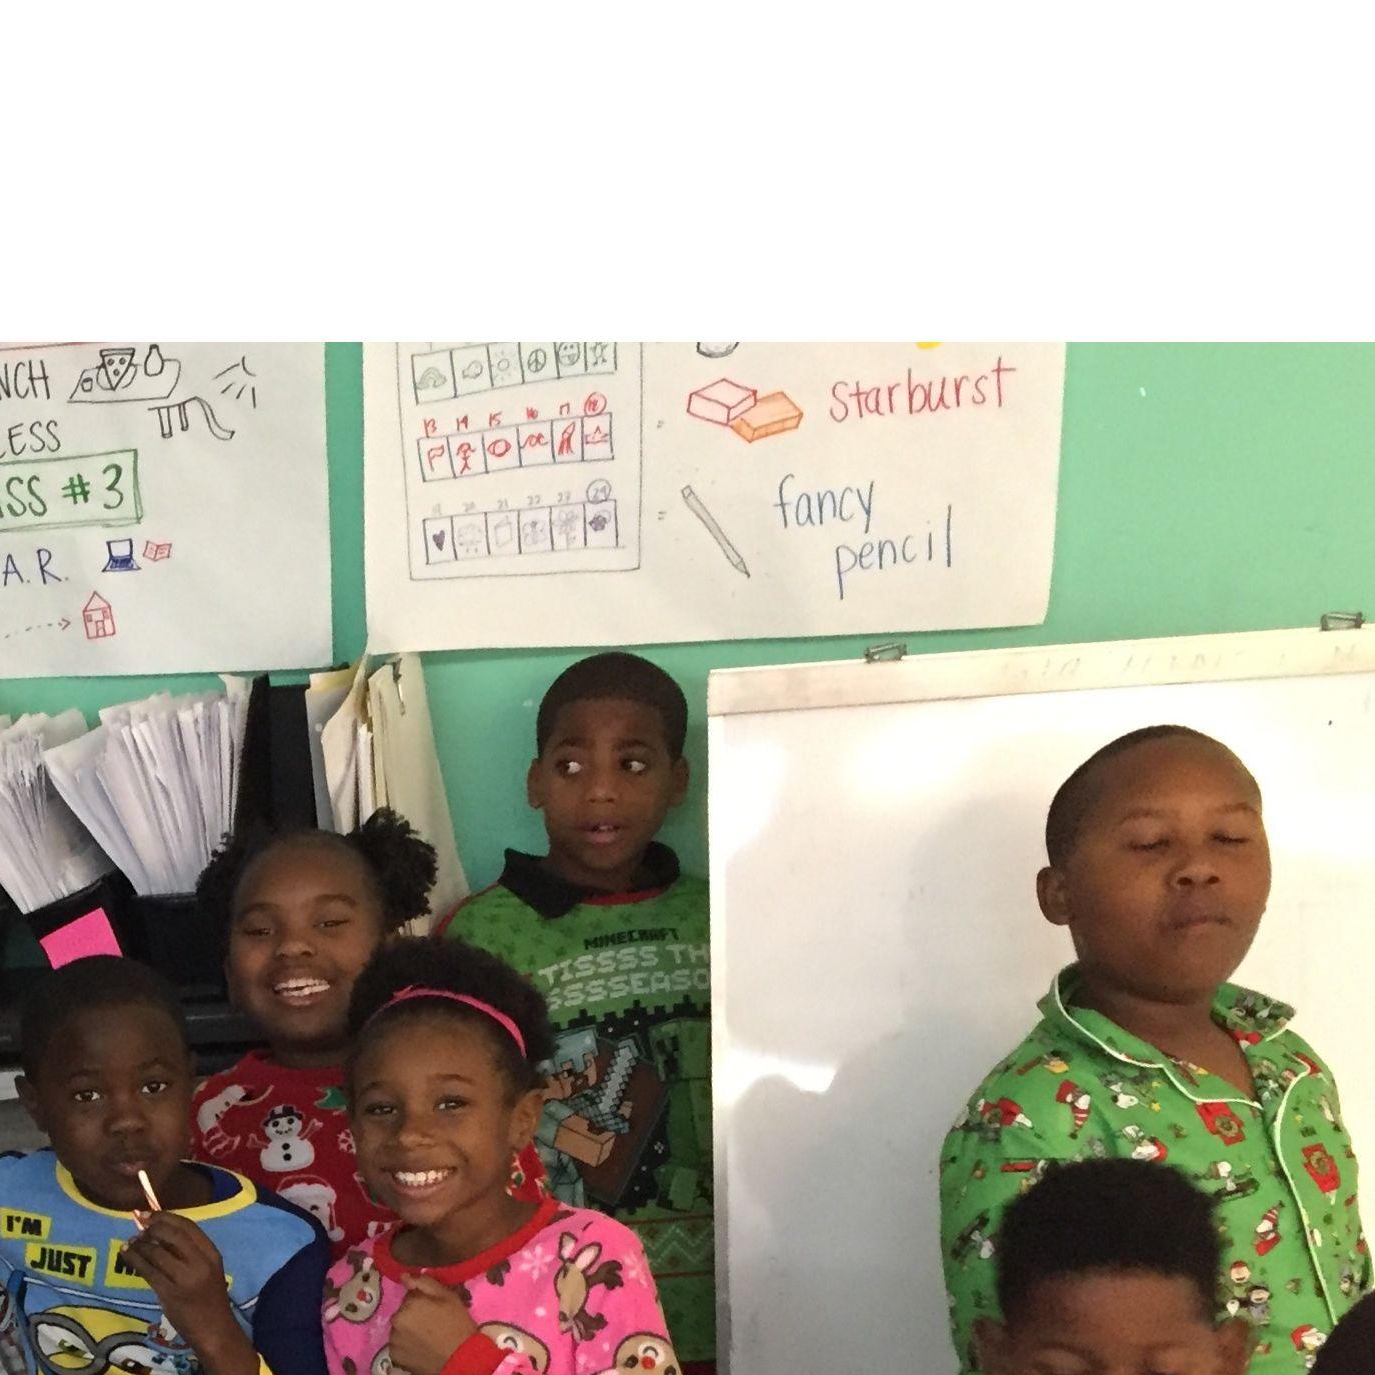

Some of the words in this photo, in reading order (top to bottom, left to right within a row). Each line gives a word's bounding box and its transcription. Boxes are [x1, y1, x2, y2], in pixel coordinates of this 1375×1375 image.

[488, 410, 503, 428] 15
[773, 473, 875, 534] fancy
[836, 504, 952, 601] pencil
[583, 927, 680, 951] MINECRAFT
[537, 944, 659, 987] TISSSS
[6, 1215, 43, 1237] I'M
[30, 1247, 92, 1279] JUST
